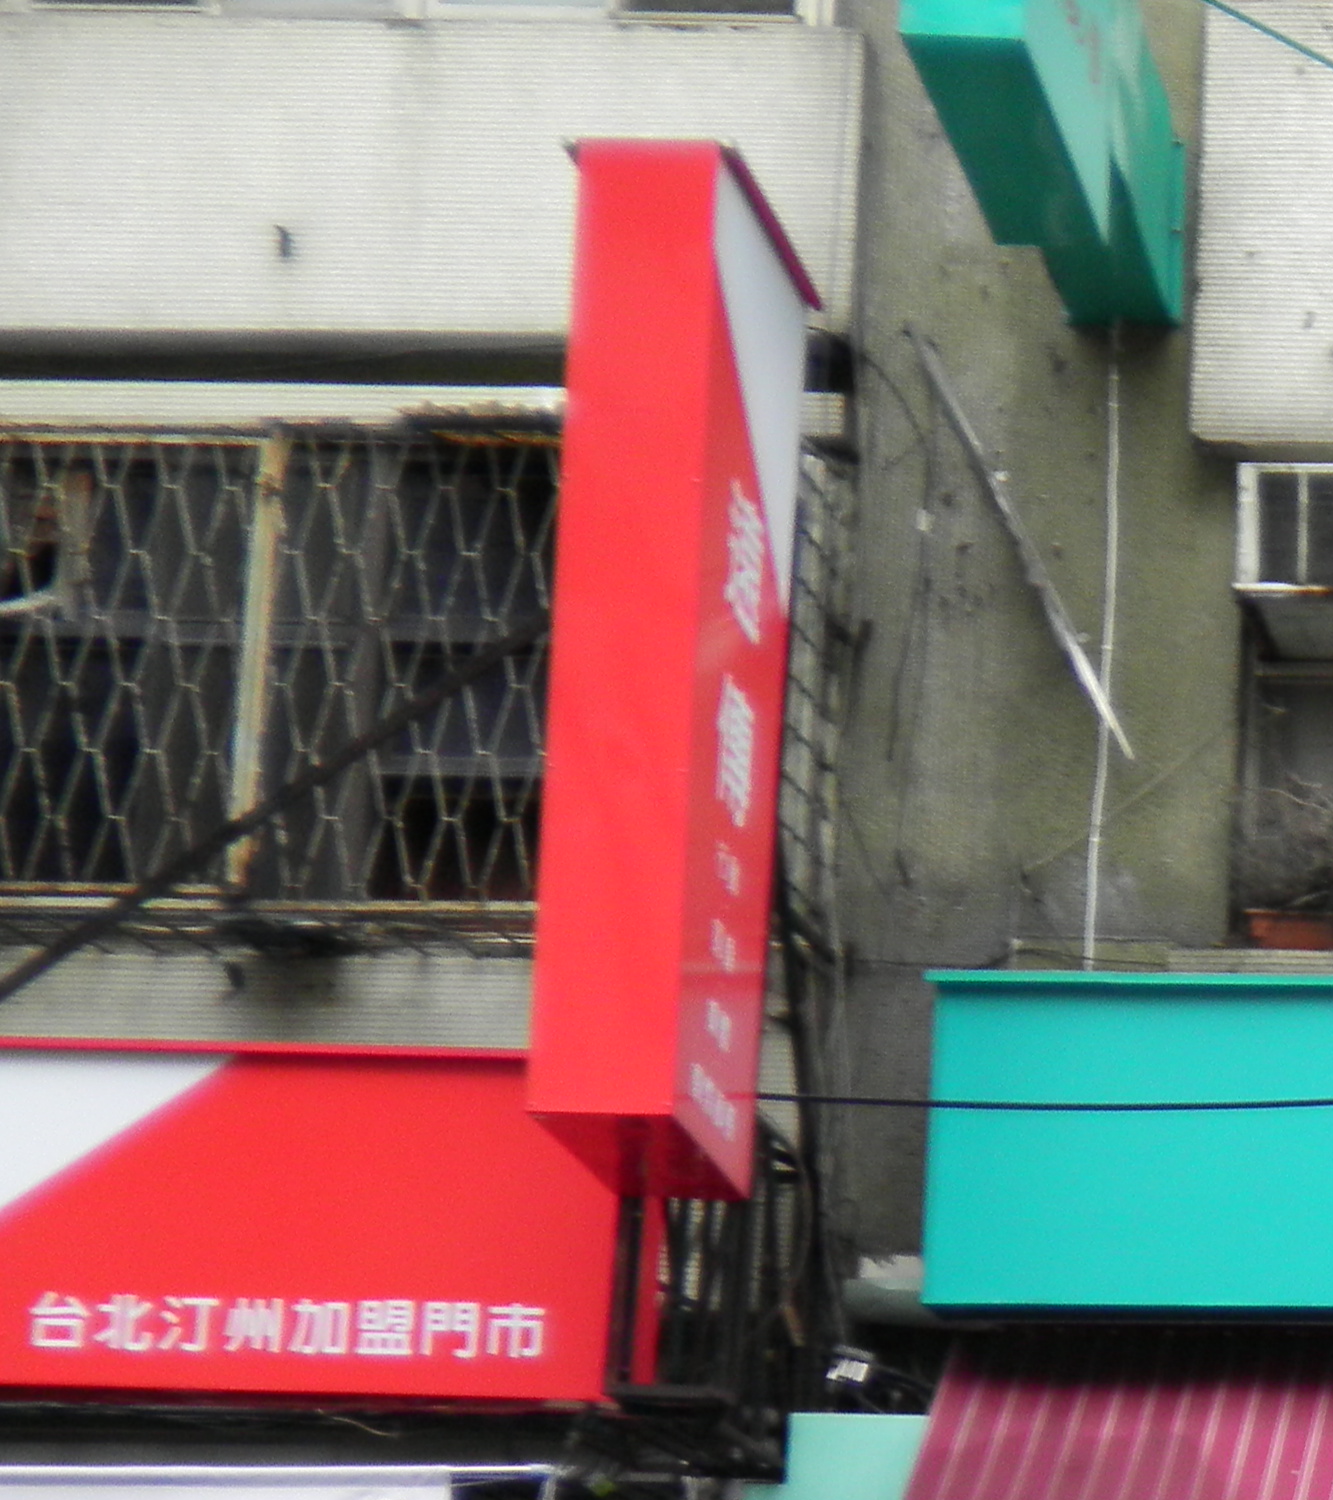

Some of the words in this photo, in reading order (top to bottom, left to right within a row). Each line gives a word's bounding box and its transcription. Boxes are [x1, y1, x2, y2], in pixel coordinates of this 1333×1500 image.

[29, 1291, 547, 1359] 台北汀州加盟門市
